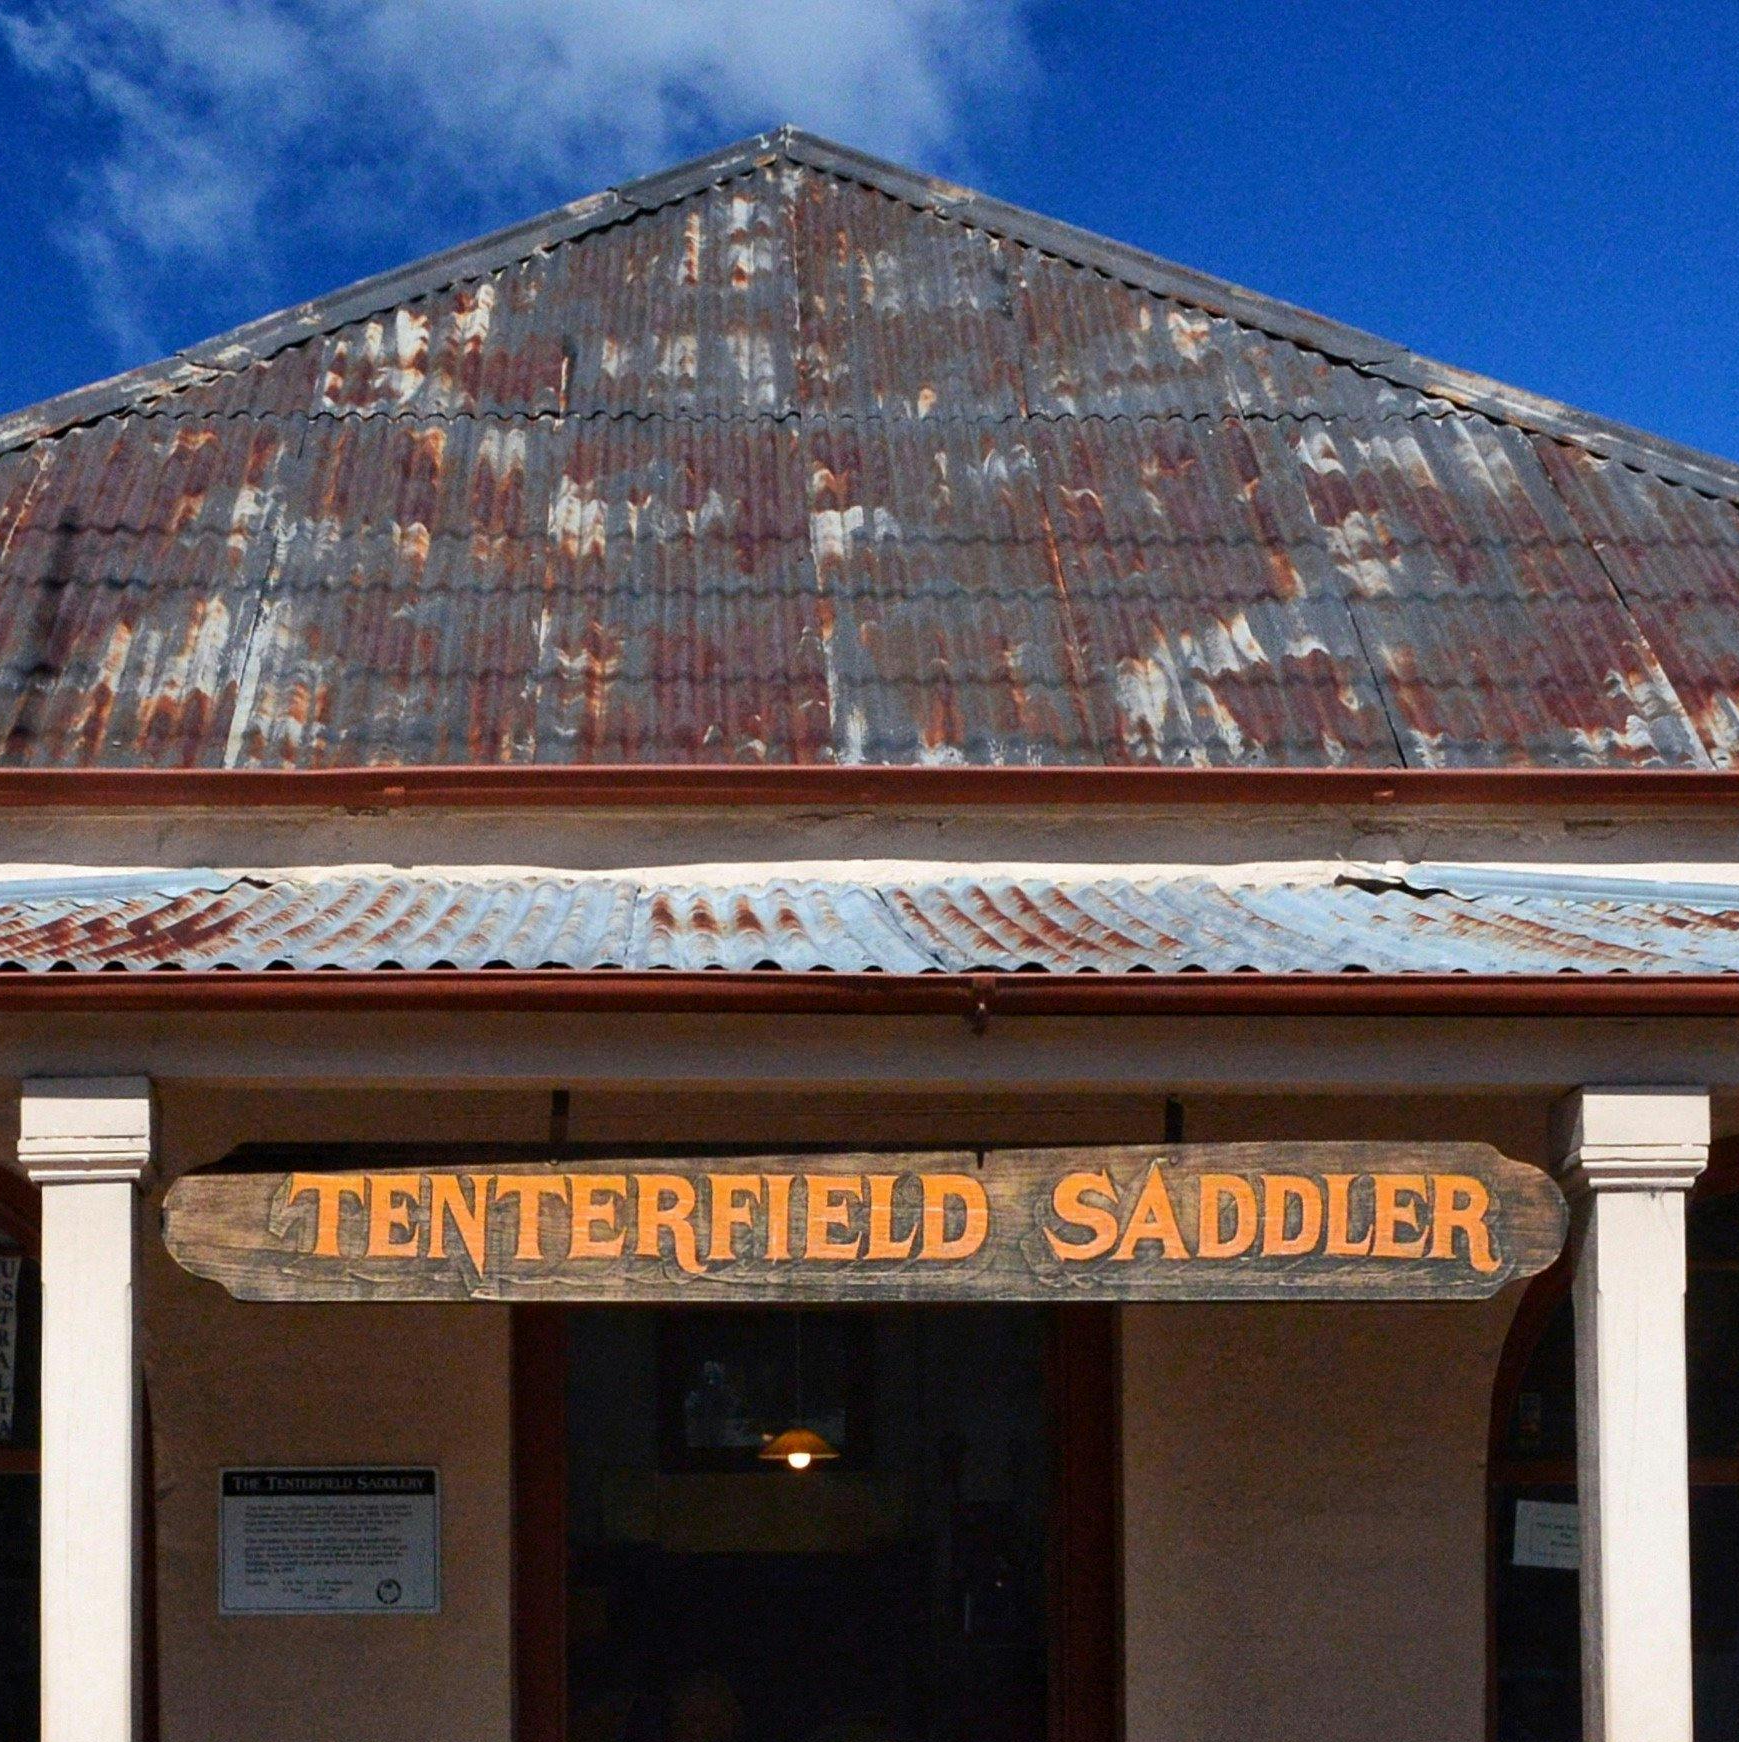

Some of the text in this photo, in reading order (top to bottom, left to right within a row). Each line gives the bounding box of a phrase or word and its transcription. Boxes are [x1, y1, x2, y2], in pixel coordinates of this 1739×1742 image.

[286, 1163, 1504, 1278] TENTERFIELD SADDLER
[232, 1475, 425, 1491] THE TENTERFIELD SADDLERY
